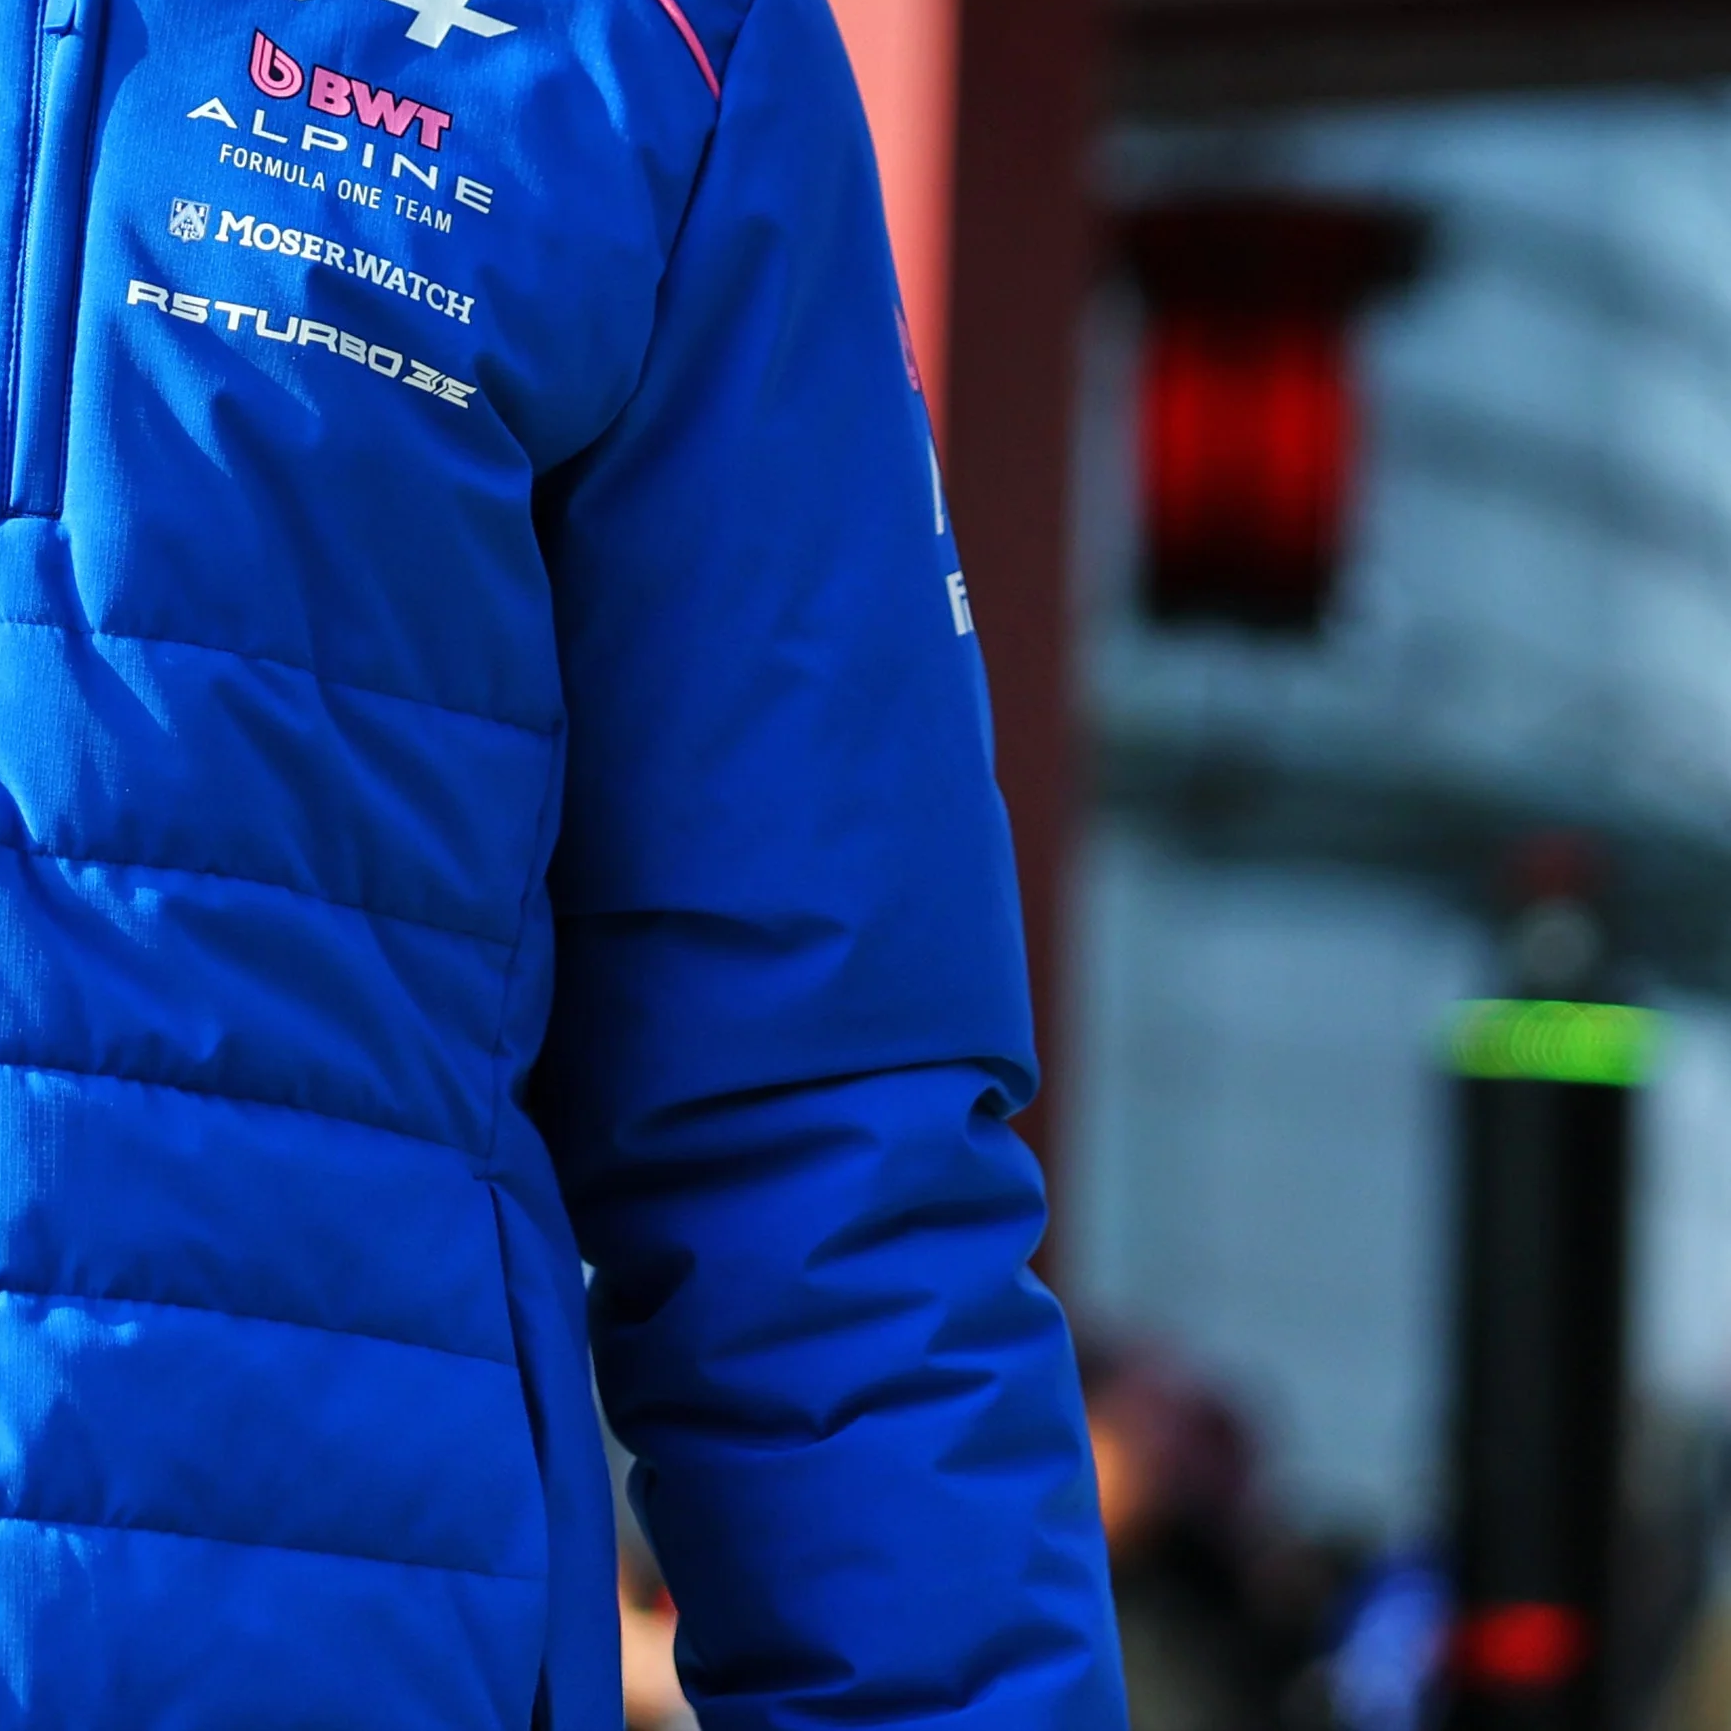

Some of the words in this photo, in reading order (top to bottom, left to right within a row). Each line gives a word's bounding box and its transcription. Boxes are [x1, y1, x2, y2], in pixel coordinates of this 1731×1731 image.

[307, 65, 452, 151] BWT
[186, 97, 494, 214] ALPINE
[219, 143, 326, 192] FORMULA
[337, 178, 383, 209] ONE
[394, 194, 452, 233] TEAM
